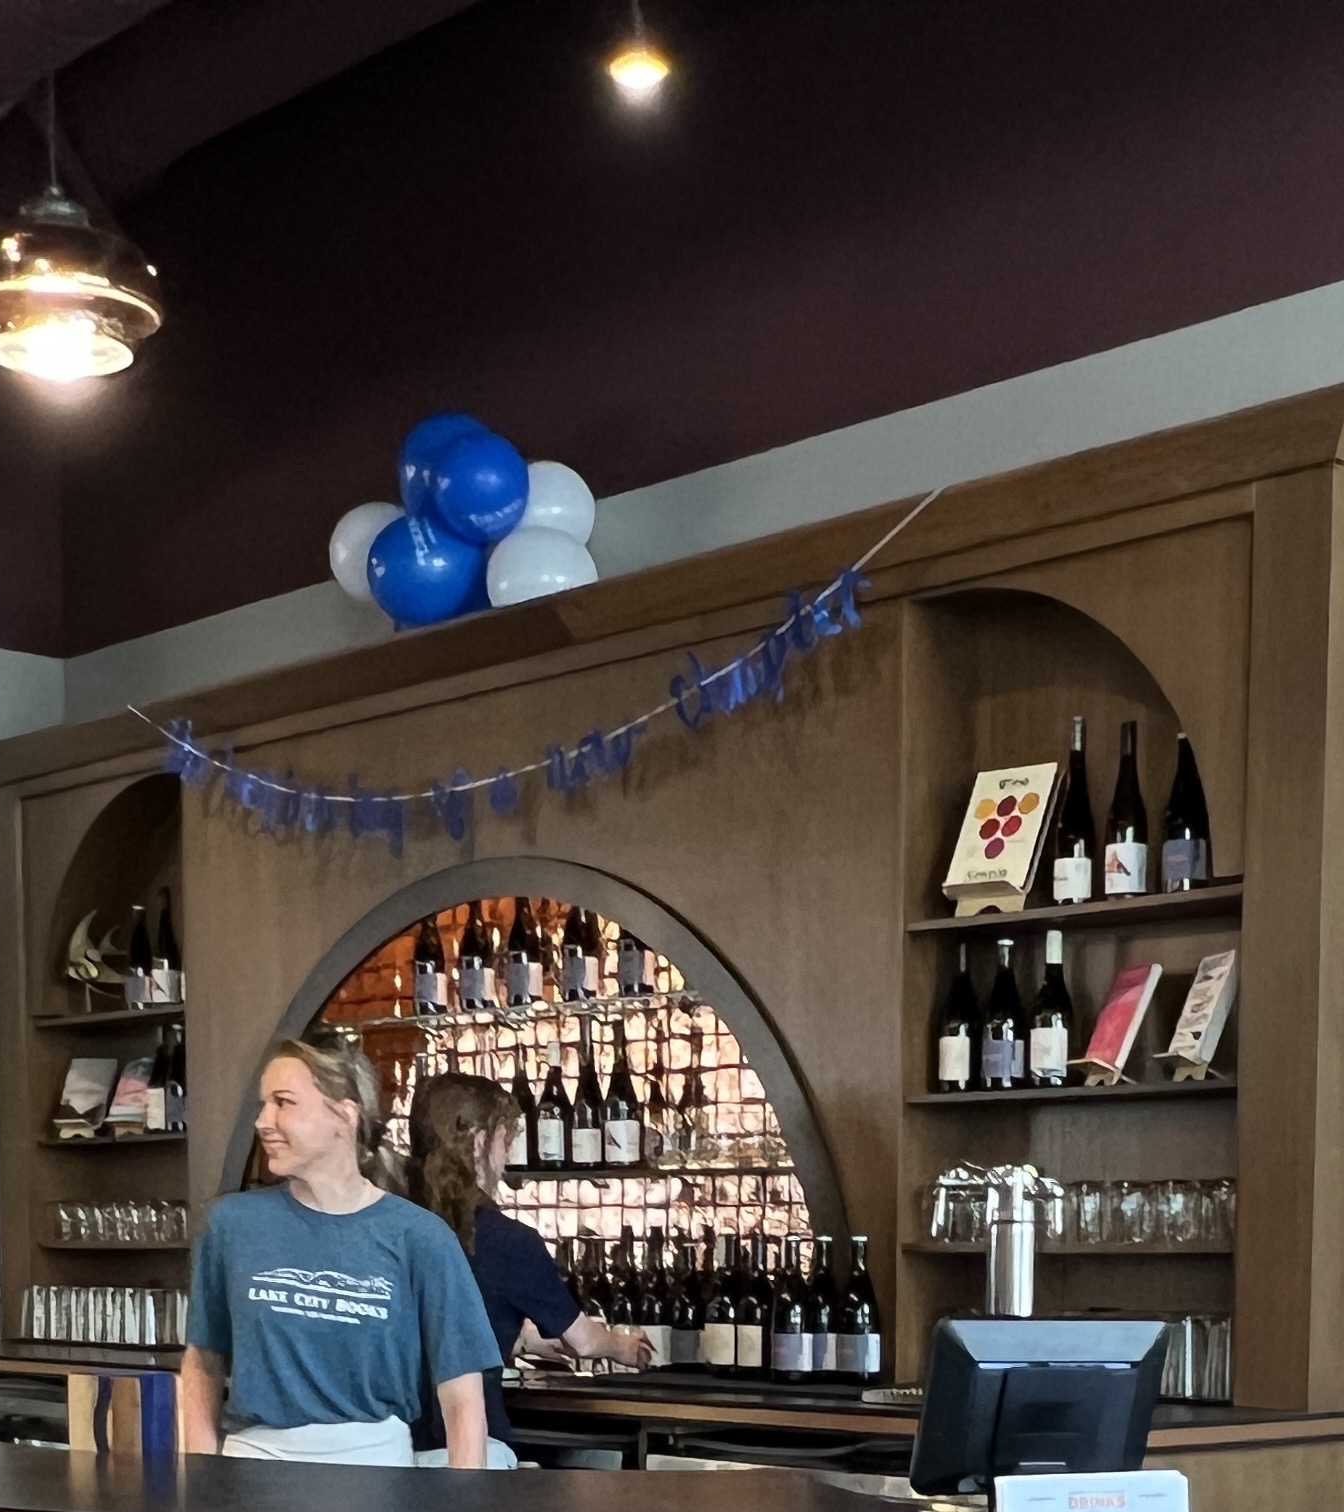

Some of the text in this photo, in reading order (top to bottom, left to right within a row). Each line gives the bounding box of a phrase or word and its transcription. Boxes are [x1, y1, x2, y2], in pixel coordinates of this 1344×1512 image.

[248, 1288, 289, 1303] LAKE
[294, 1292, 330, 1309] CITY
[335, 1299, 388, 1320] BOOKS
[1068, 1495, 1125, 1510] DRINKS
